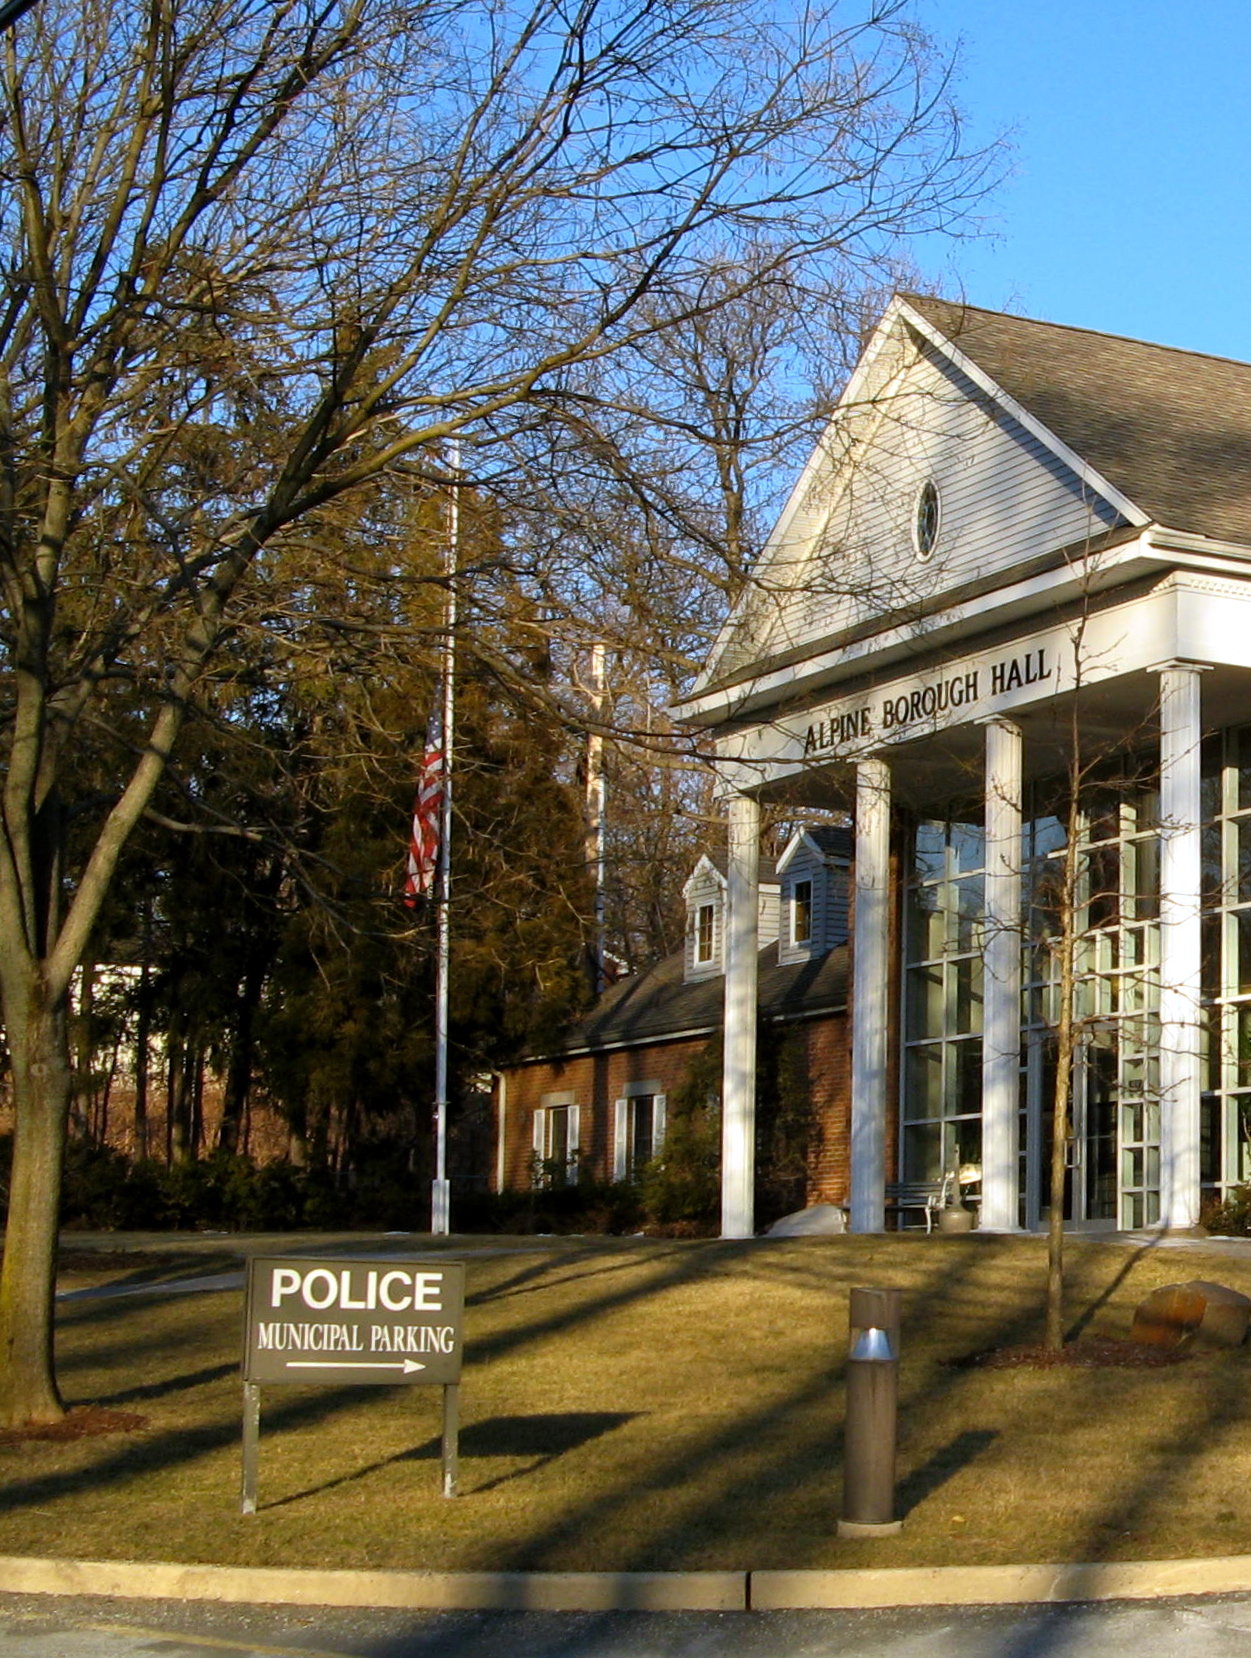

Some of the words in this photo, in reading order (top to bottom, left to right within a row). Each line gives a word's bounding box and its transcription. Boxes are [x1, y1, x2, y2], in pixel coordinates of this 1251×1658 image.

[803, 706, 873, 754] ALPINE
[883, 669, 979, 726] BOROUGH
[990, 648, 1052, 696] HALL
[271, 1268, 443, 1311] POLICE
[257, 1322, 364, 1351] MUNICIPAL
[370, 1325, 455, 1354] PARKING
